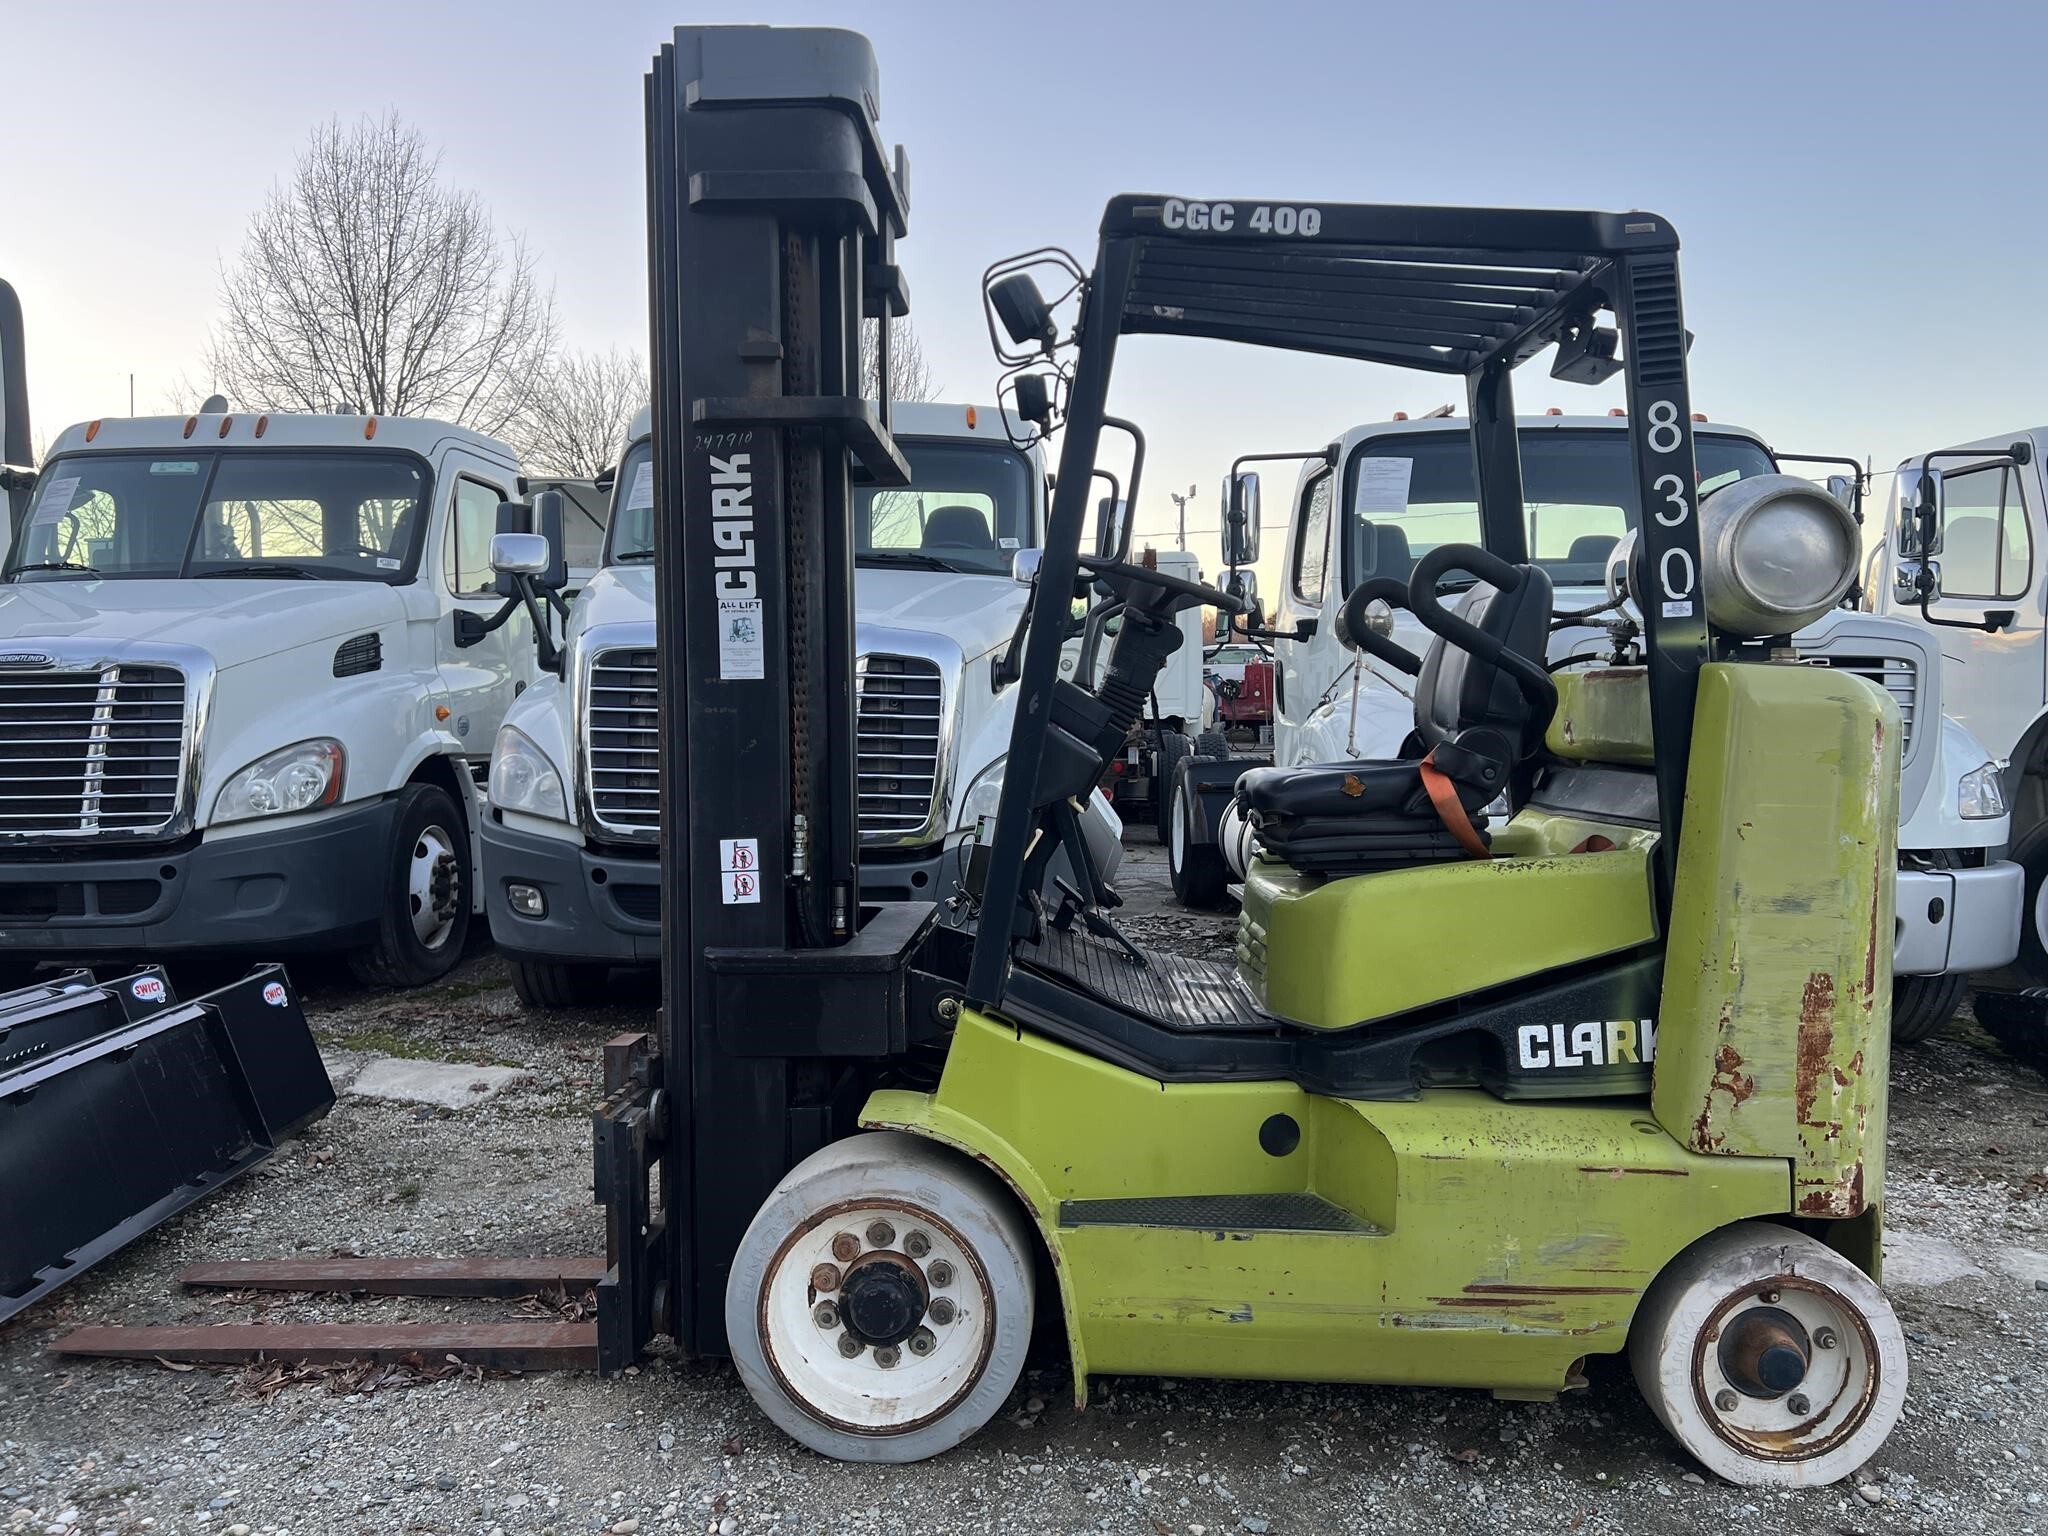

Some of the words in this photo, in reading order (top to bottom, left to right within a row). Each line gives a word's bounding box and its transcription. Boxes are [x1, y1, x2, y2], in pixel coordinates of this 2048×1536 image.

[1163, 198, 1235, 232] CGC
[1250, 206, 1322, 237] 400
[693, 431, 753, 452] 247910
[1647, 400, 1695, 601] 830
[710, 453, 757, 600] CLARK
[135, 982, 161, 995] SWICT
